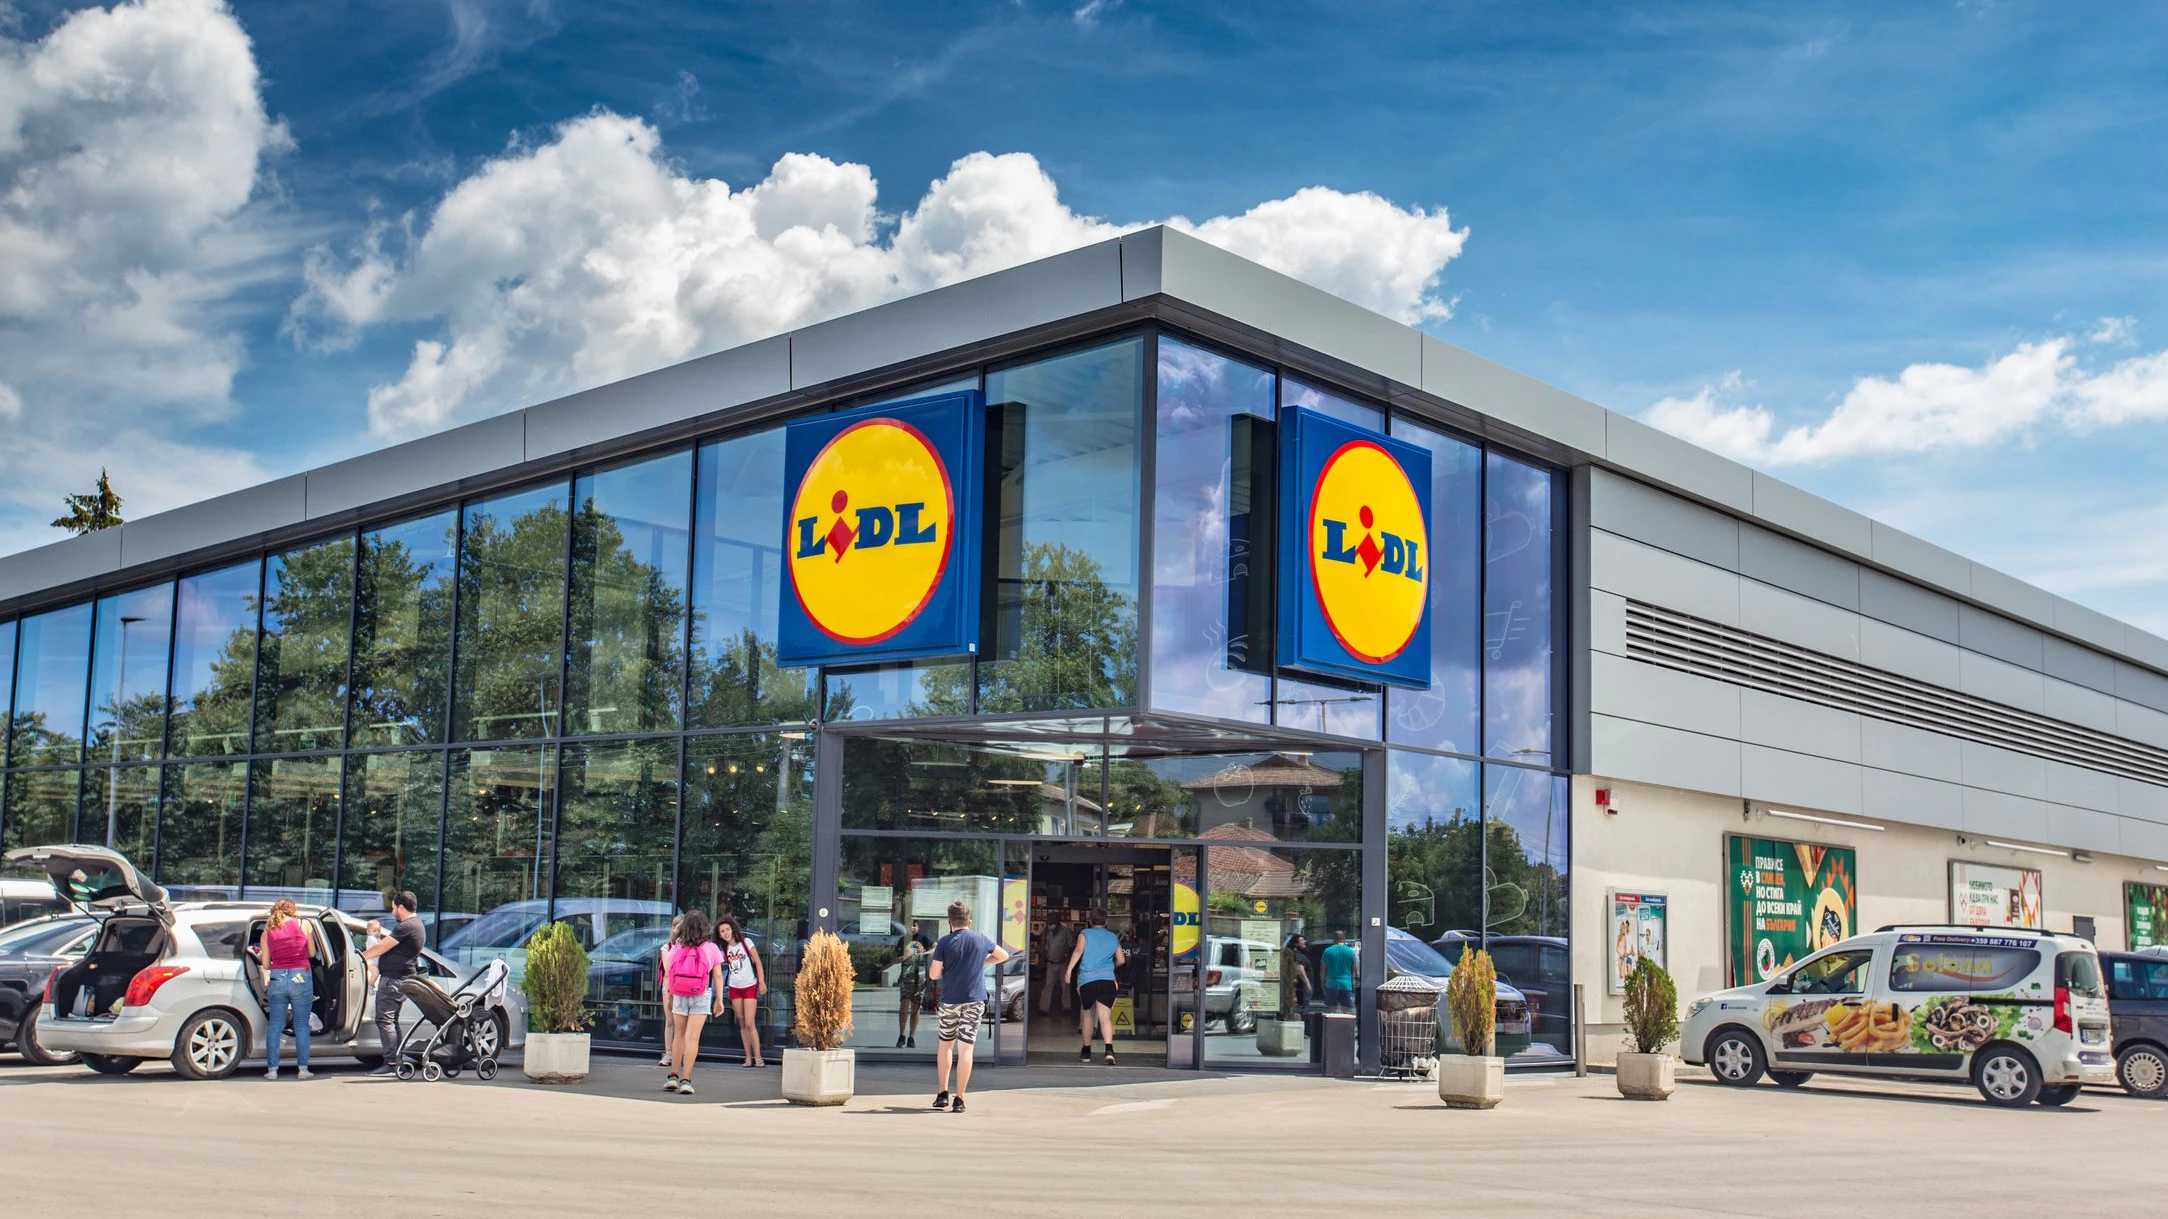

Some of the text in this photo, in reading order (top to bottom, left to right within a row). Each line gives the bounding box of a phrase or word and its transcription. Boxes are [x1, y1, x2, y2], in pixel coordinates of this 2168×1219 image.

[1776, 858, 1783, 871] СЕ
[1756, 871, 1760, 883] В
[1756, 886, 1784, 900] НО СТИГА
[1756, 899, 1802, 916] ДО ВСЕКИ КРАЙ
[1756, 917, 1766, 930] НА
[1989, 938, 2002, 946] 887
[2004, 939, 2017, 947] 776
[2019, 940, 2032, 948] 107
